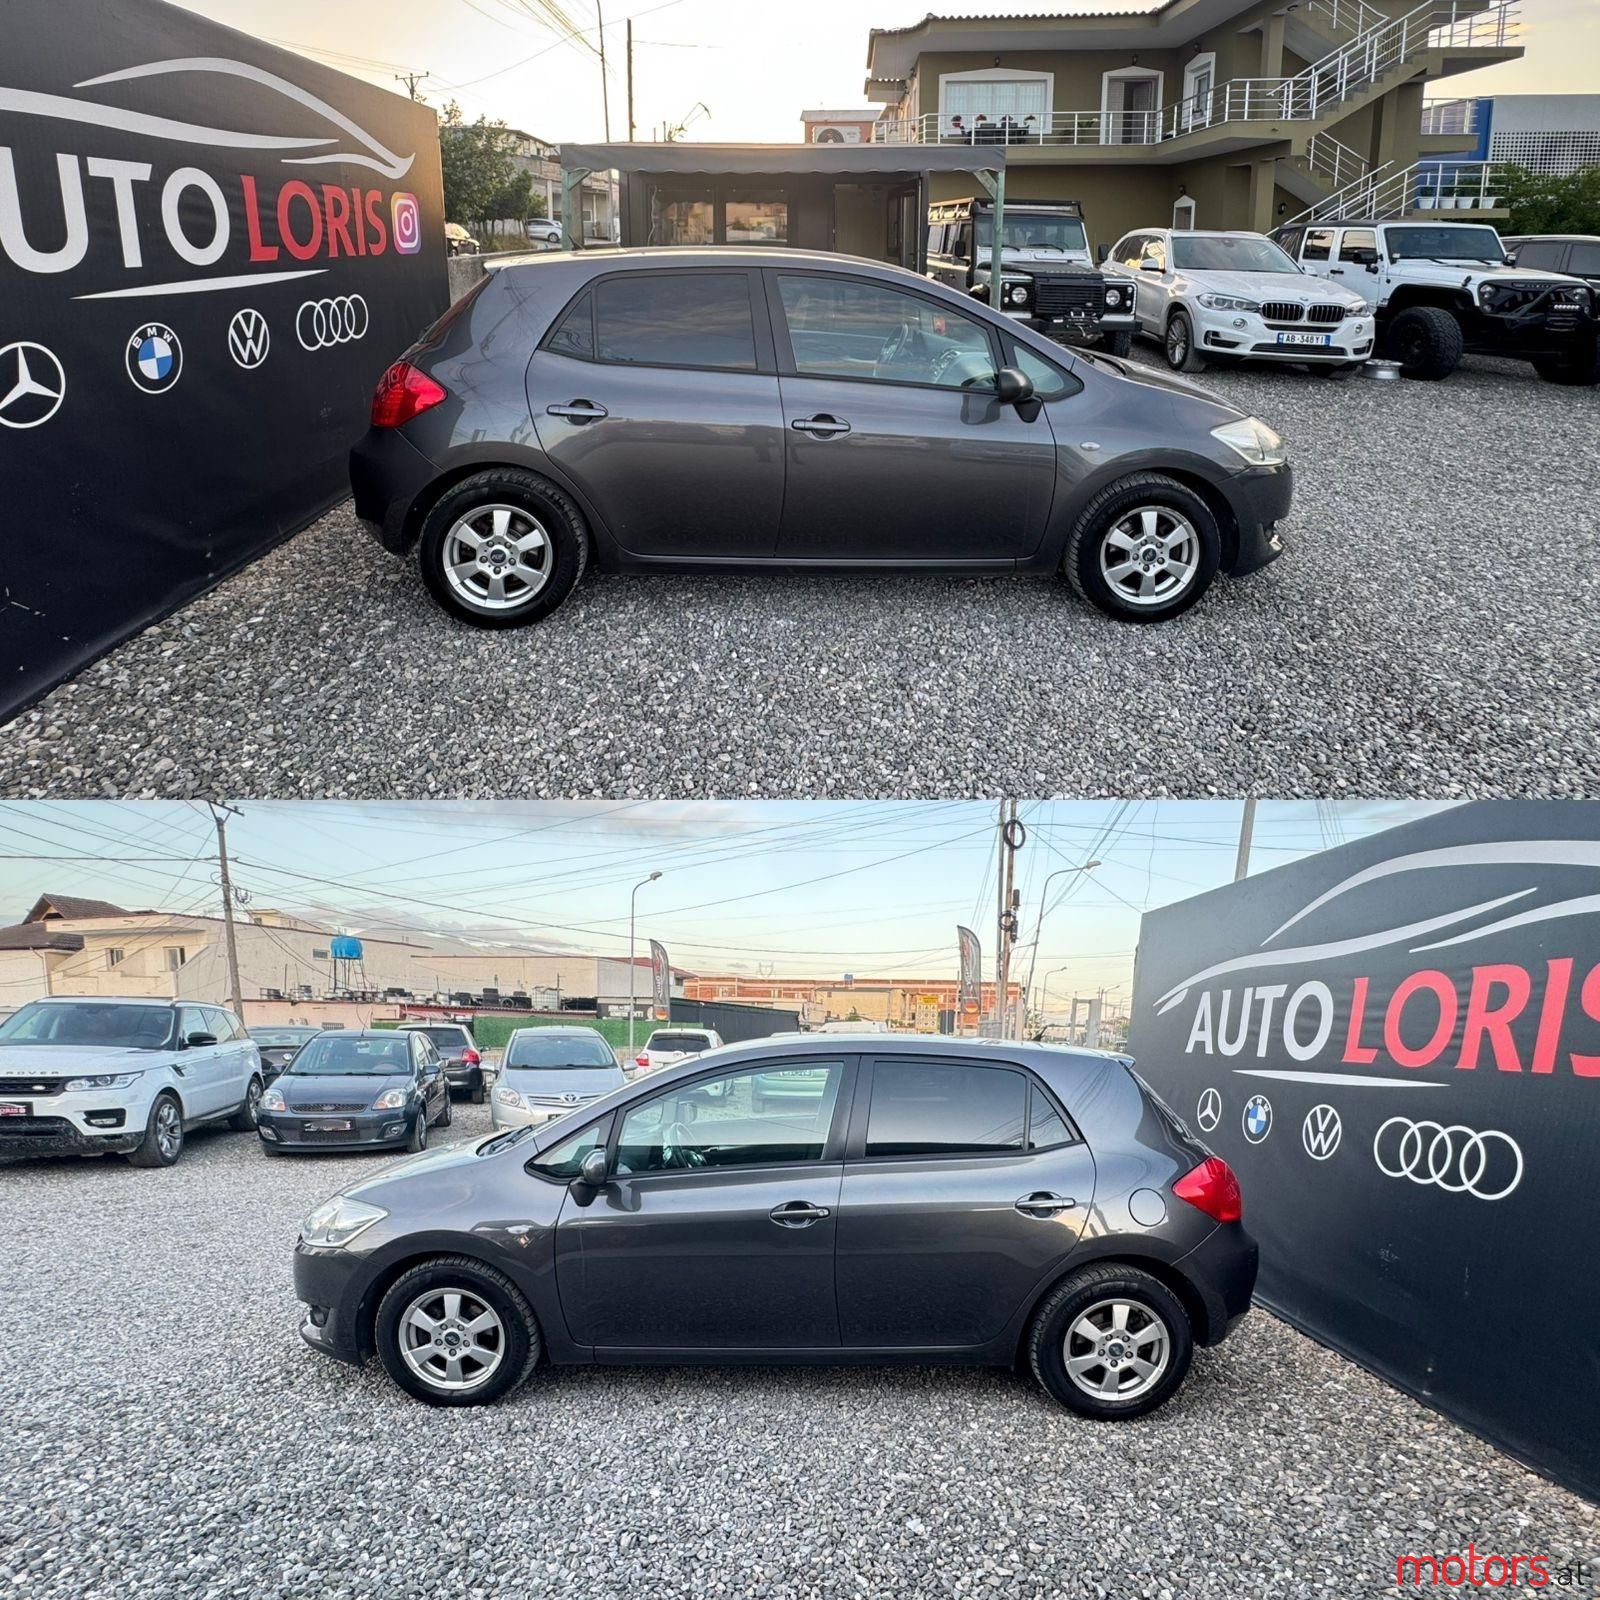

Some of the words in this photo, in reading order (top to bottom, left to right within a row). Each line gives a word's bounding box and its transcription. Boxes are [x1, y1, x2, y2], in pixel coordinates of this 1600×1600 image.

[240, 175, 387, 262] LORIS
[132, 326, 174, 350] BMW
[1185, 980, 1334, 1061] AUTO
